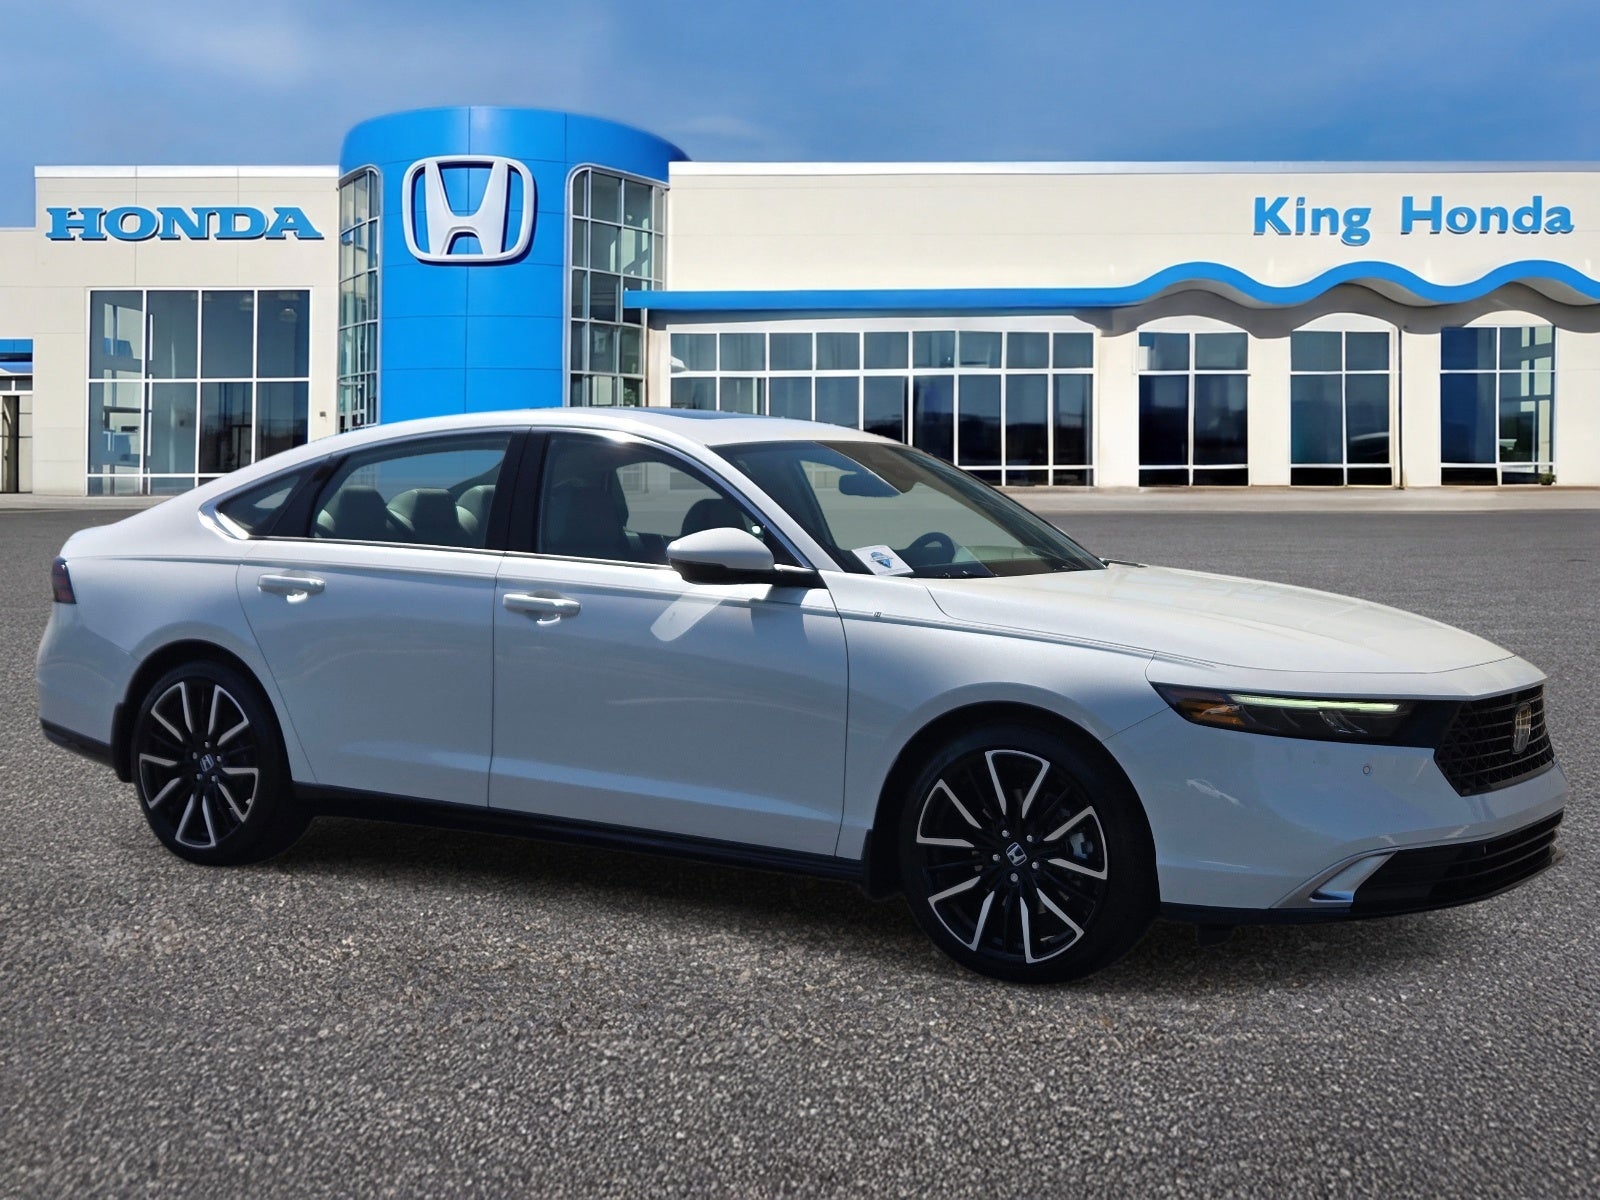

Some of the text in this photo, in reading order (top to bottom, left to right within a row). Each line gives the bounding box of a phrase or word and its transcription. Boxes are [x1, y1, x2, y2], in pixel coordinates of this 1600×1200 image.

[46, 206, 325, 241] HONDA
[1253, 195, 1575, 247] King Honda
